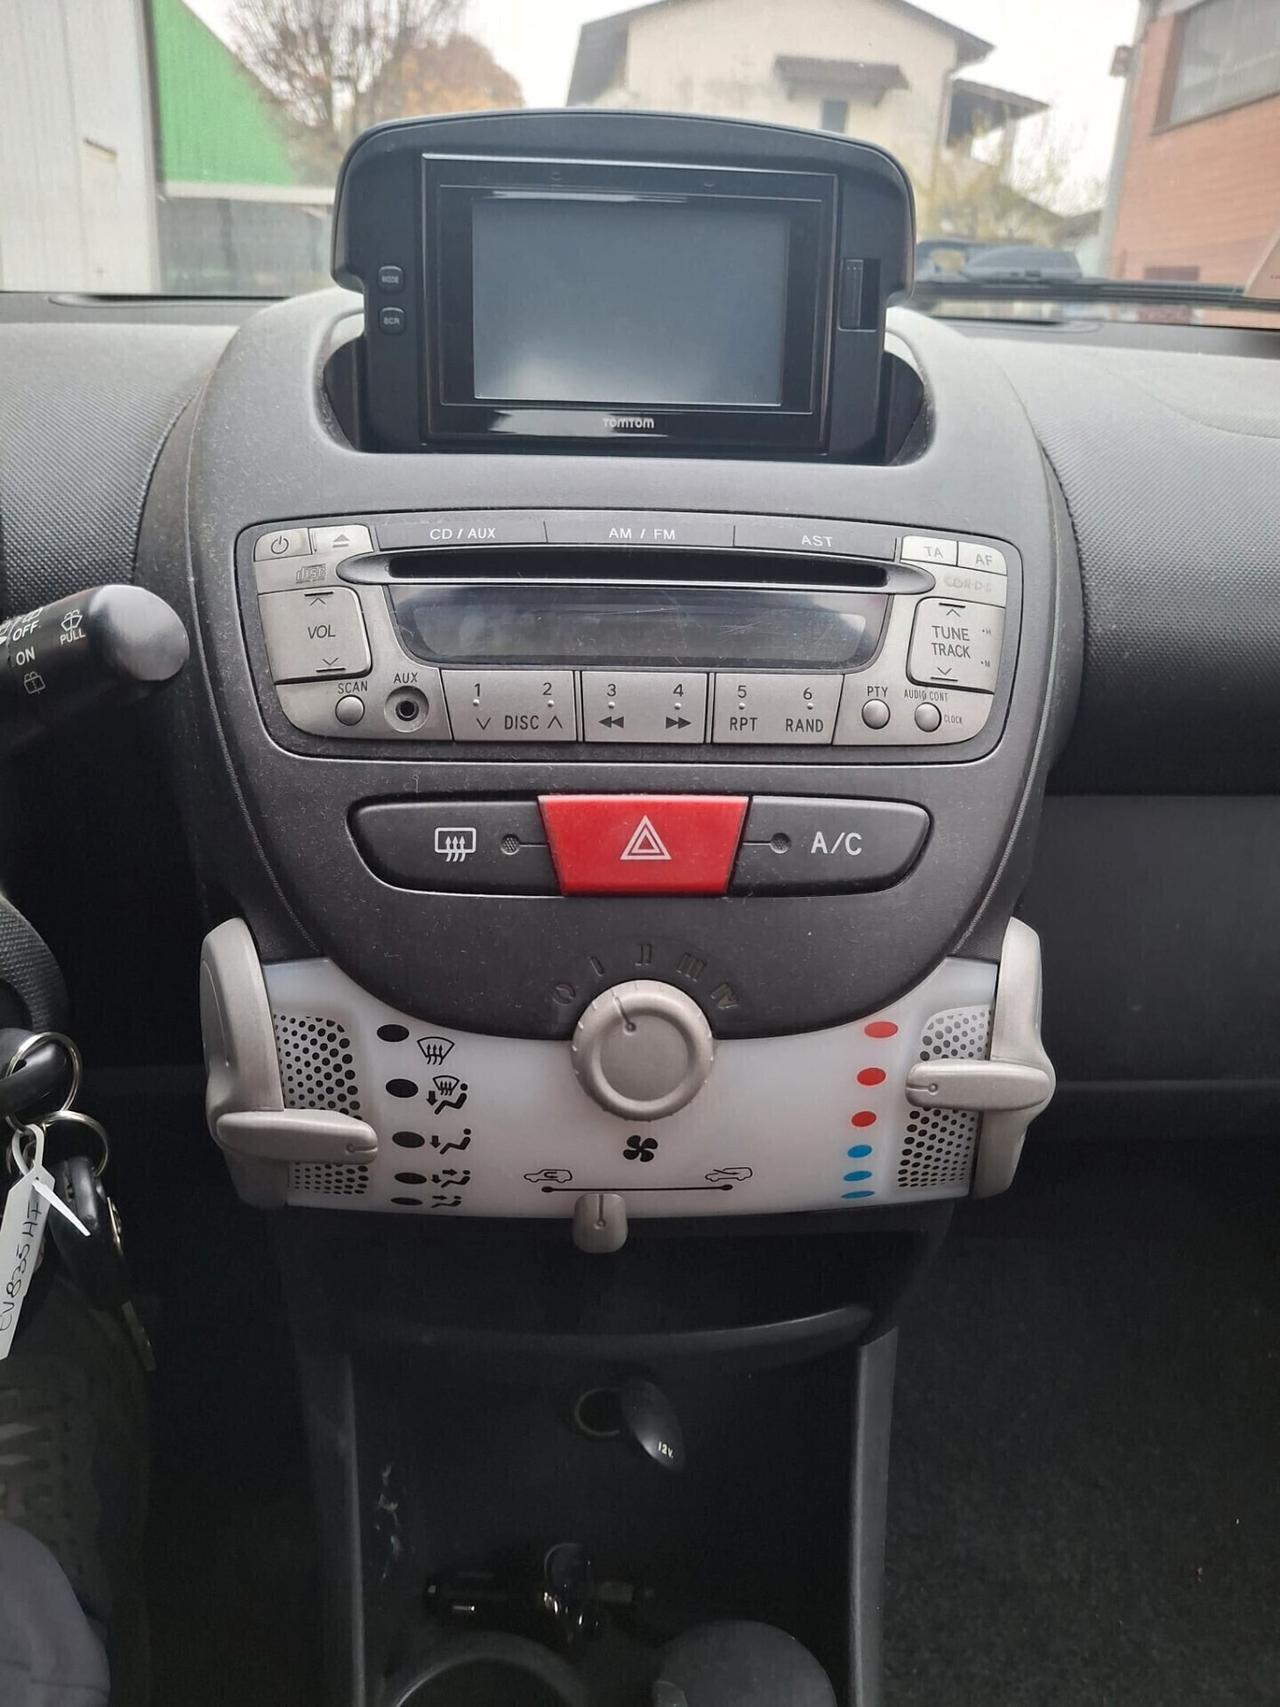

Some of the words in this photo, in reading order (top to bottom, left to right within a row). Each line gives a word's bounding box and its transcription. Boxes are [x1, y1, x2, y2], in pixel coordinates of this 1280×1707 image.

[429, 528, 453, 540] CD
[467, 527, 496, 539] AUX
[608, 527, 632, 540] AM
[653, 528, 676, 541] FM
[801, 535, 833, 548] AST
[923, 545, 944, 559] TA
[975, 552, 993, 567] AF
[13, 619, 40, 641] OFF
[60, 629, 86, 645] PULL
[307, 624, 336, 639] VOL
[931, 625, 970, 641] TUNE
[16, 646, 36, 666] ON
[931, 642, 971, 659] TRACK
[393, 672, 418, 684] AUX
[337, 680, 368, 694] SCAN
[474, 683, 481, 697] 1
[542, 682, 553, 696] 2
[606, 683, 617, 697] 3
[672, 683, 684, 697] 4
[737, 685, 747, 699] 5
[803, 687, 813, 700] 6
[866, 686, 888, 697] PTY
[904, 688, 927, 701] AUDIO
[929, 691, 948, 703] CONT
[504, 715, 539, 730] DISC
[729, 717, 758, 732] RPT
[785, 718, 824, 733] RAND
[943, 714, 962, 725] CLOCK
[810, 831, 862, 856] A/C
